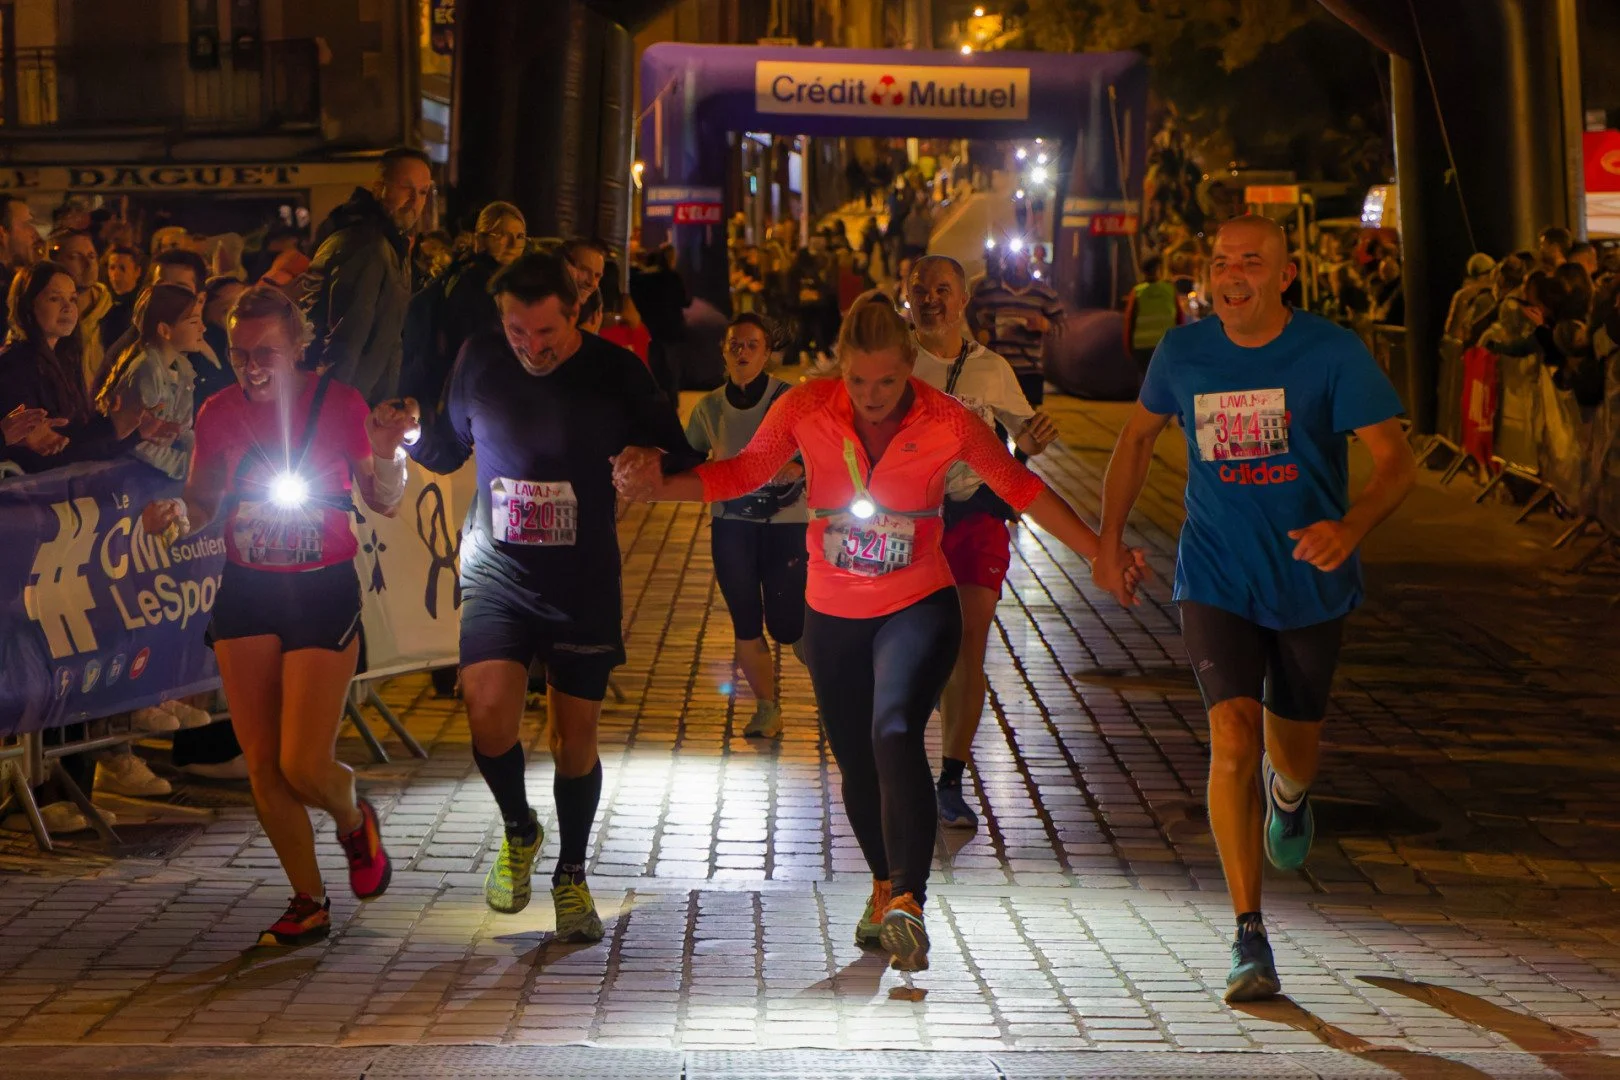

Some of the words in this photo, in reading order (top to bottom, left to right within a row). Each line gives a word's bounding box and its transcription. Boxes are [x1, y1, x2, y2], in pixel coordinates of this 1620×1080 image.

[771, 75, 867, 104] Crédit
[909, 81, 1016, 108] Mutuel
[68, 166, 299, 188] DAGUET
[1215, 411, 1261, 443] 344
[112, 491, 129, 509] Le
[508, 499, 555, 529] 520
[845, 527, 887, 561] 521
